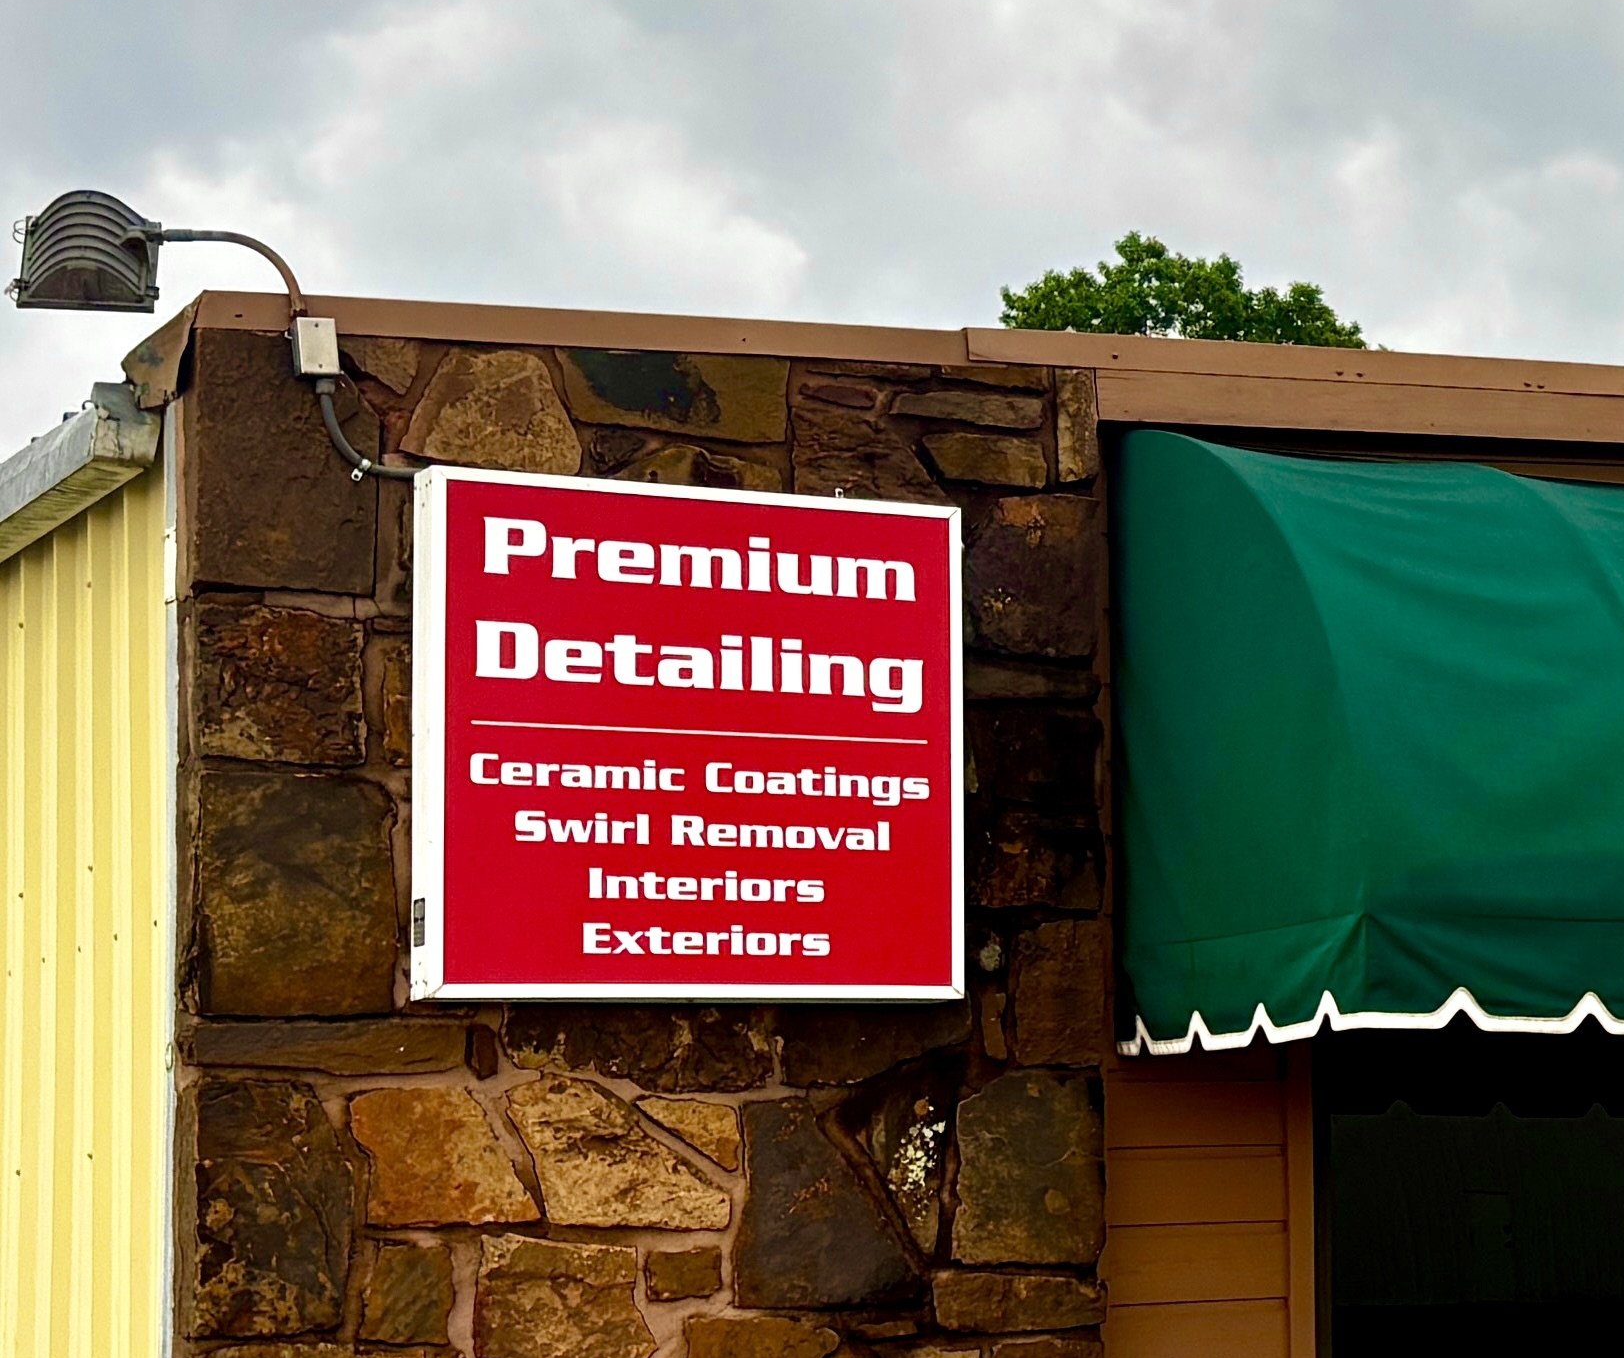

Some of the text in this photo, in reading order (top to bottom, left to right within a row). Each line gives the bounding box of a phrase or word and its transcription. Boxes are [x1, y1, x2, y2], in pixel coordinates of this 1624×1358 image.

[483, 515, 917, 602] Premium
[474, 619, 924, 714] Detailing
[469, 753, 930, 806] Ceramic Coatings
[514, 810, 890, 851] Swirl Removal
[588, 867, 825, 903] Interiors
[582, 922, 831, 957] Exteriors
